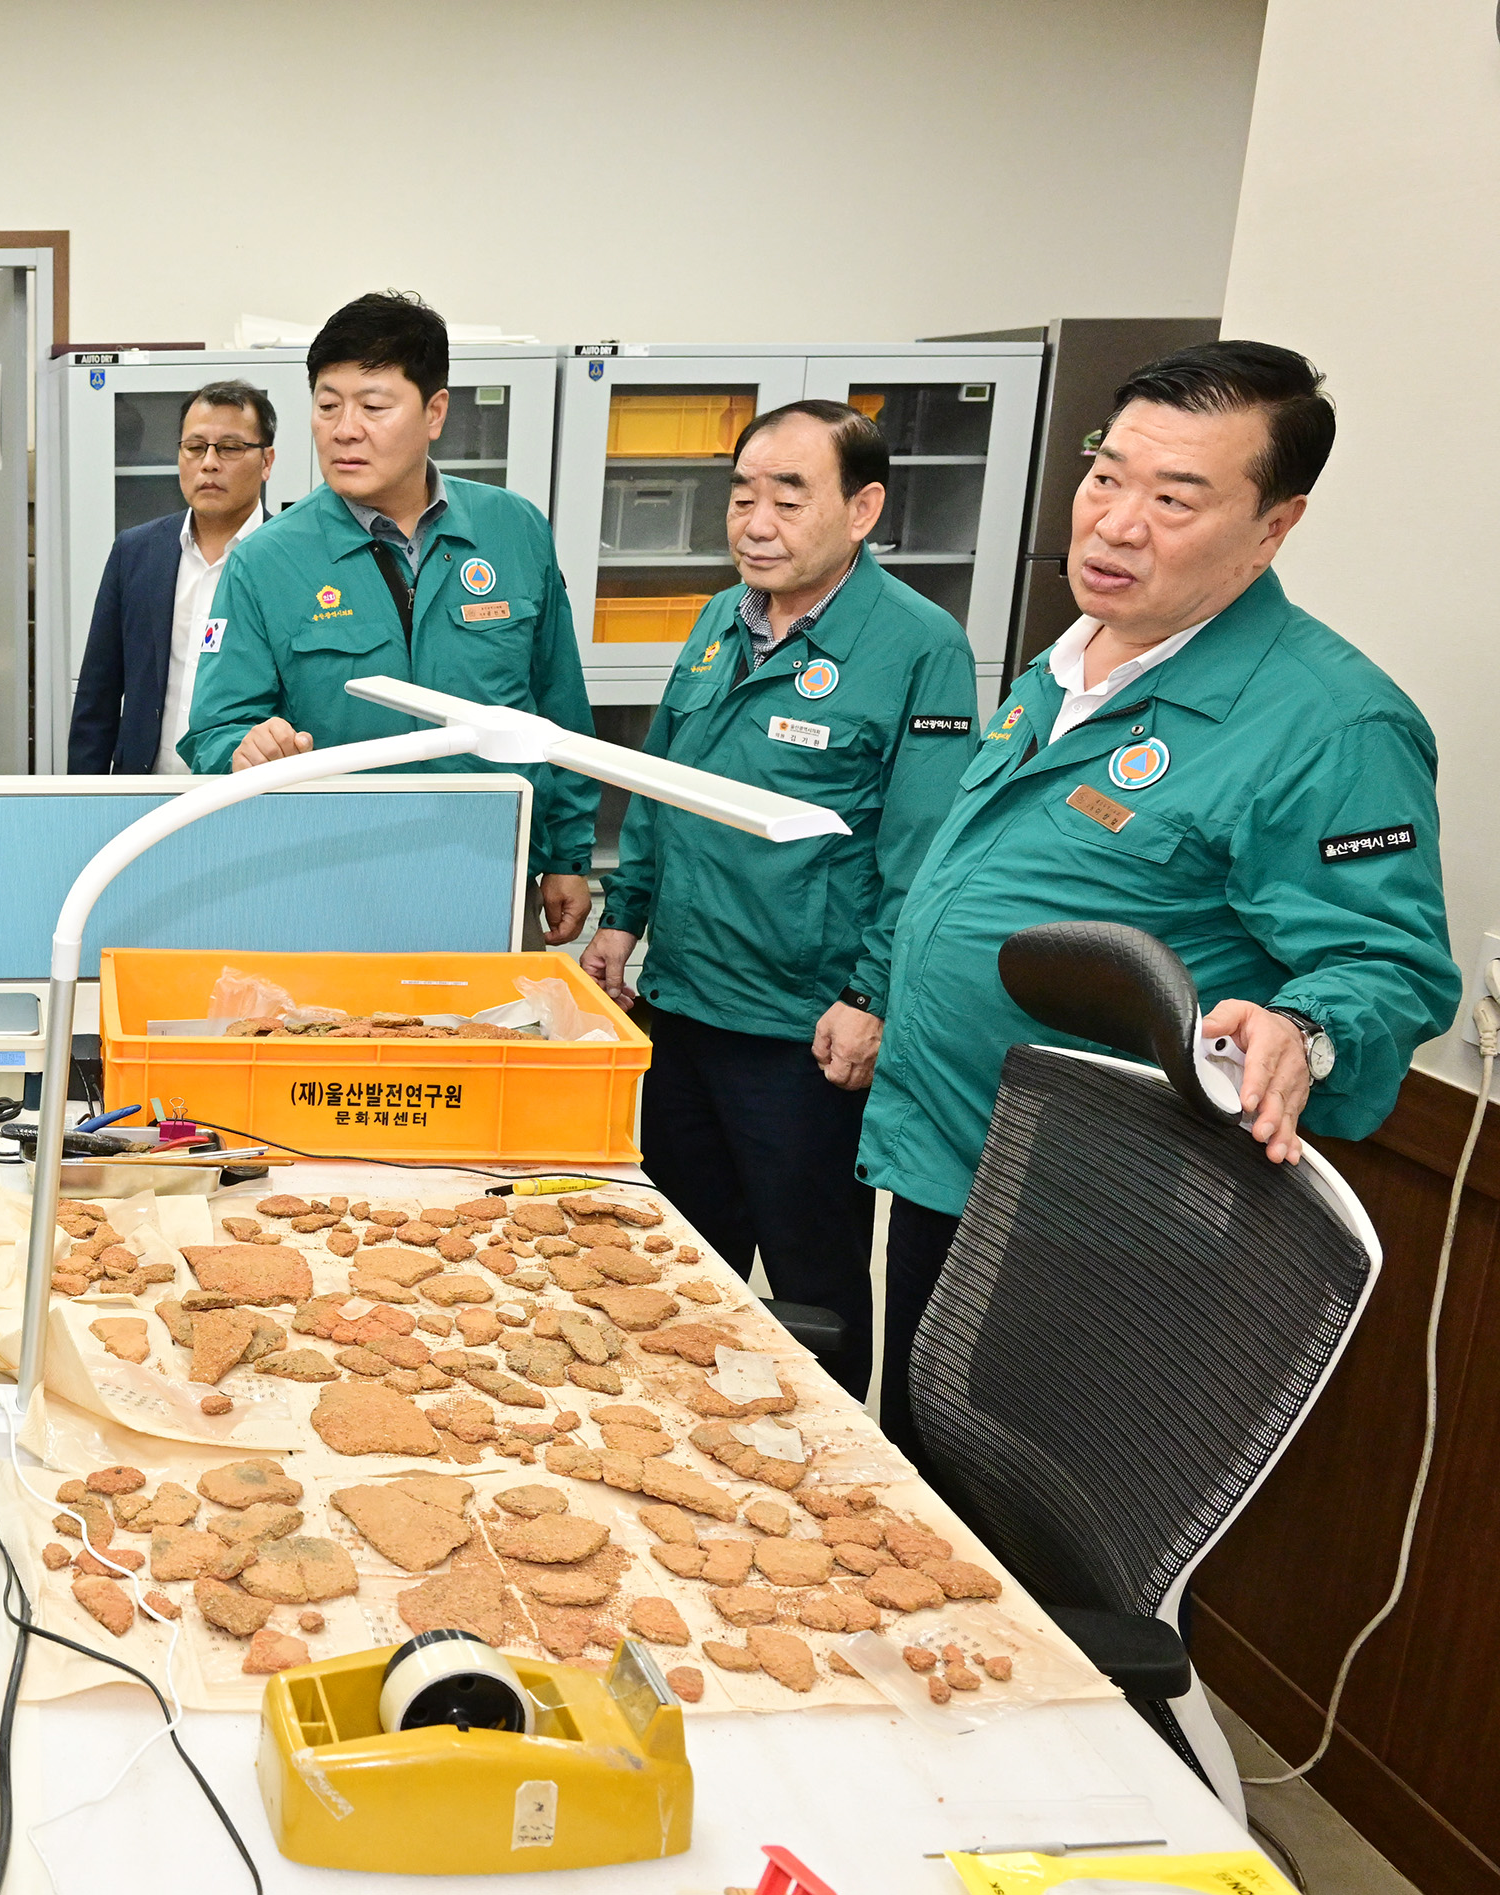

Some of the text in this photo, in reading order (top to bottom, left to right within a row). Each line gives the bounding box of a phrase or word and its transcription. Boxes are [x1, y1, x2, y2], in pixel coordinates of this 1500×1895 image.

[580, 346, 613, 355] AUTO DRY
[81, 355, 114, 364] AUTO DRY
[913, 719, 969, 730] 울산광역시 의회
[1325, 830, 1411, 857] 울산광역시 의회
[290, 1081, 463, 1109] (재)울산발전연구원
[334, 1110, 428, 1127] 문화재센터
